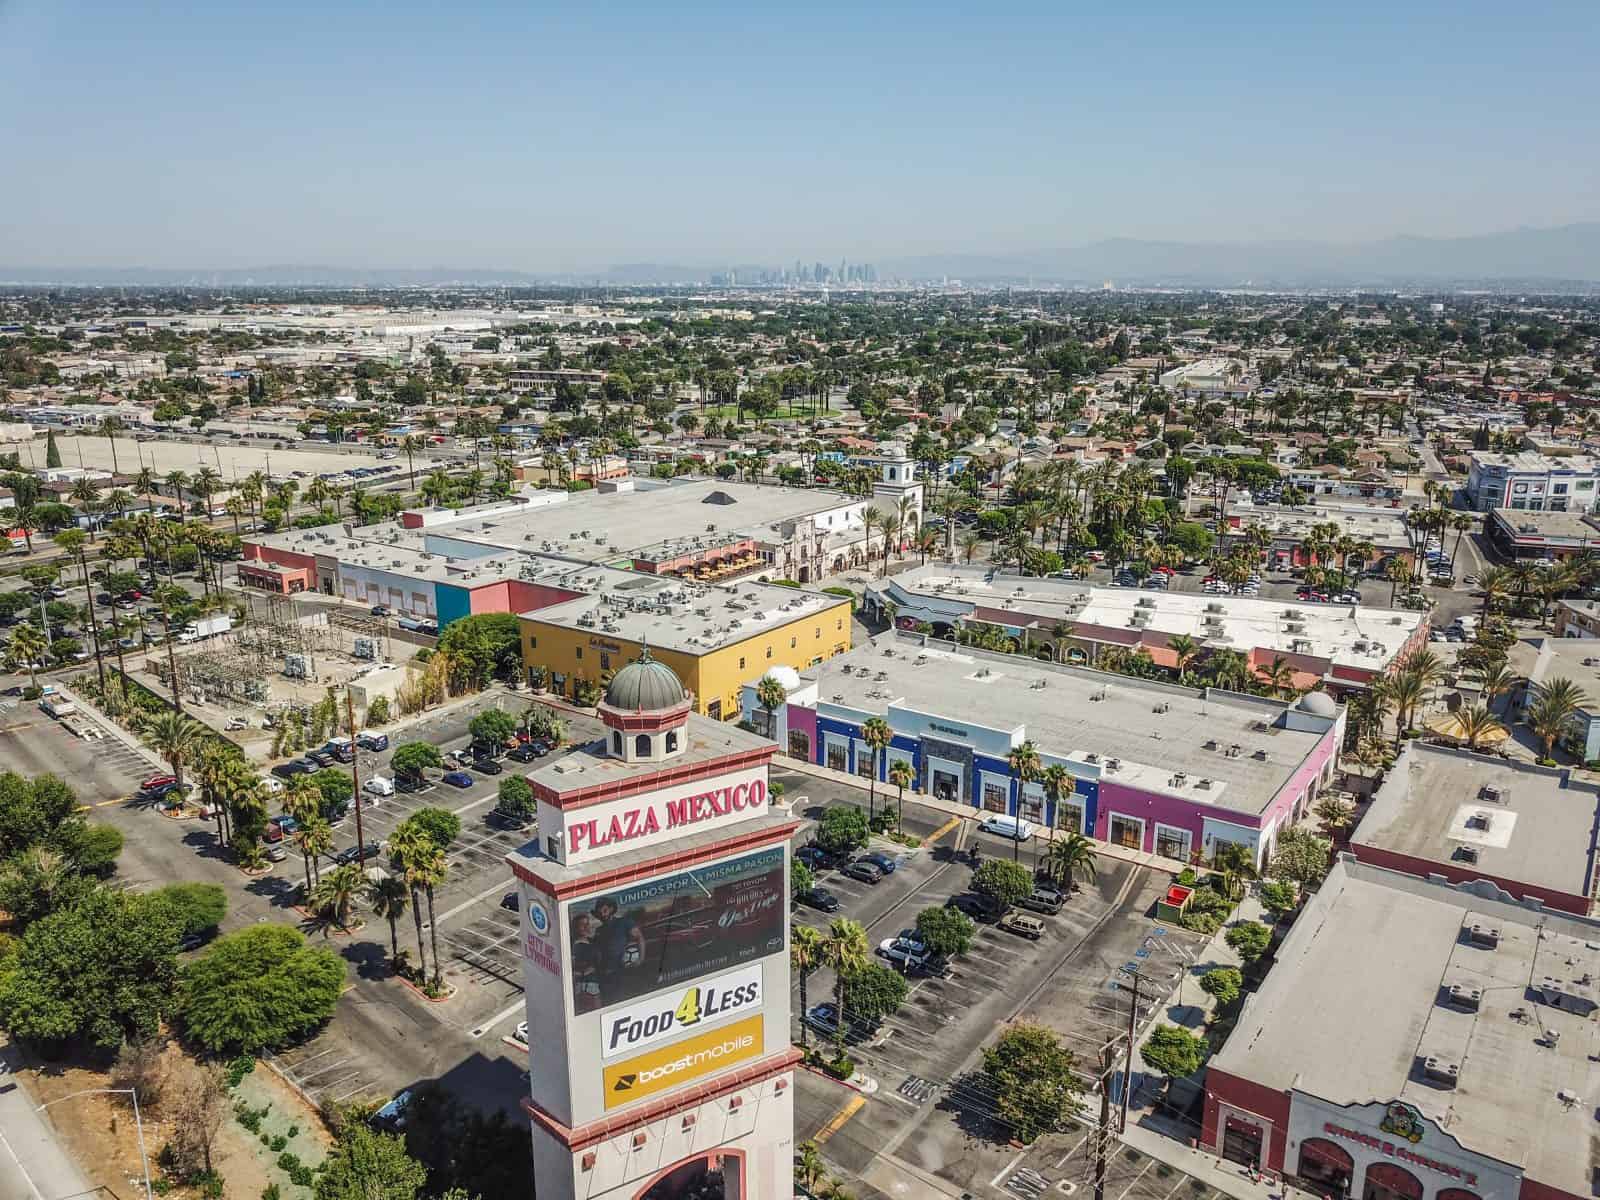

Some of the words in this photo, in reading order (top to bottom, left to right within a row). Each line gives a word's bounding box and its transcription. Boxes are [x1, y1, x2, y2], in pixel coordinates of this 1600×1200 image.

[568, 806, 660, 853] PLAZA
[665, 779, 766, 830] MEXICO
[618, 886, 664, 905] UNIDOS
[666, 877, 688, 893] POR
[705, 863, 742, 881] MISMA
